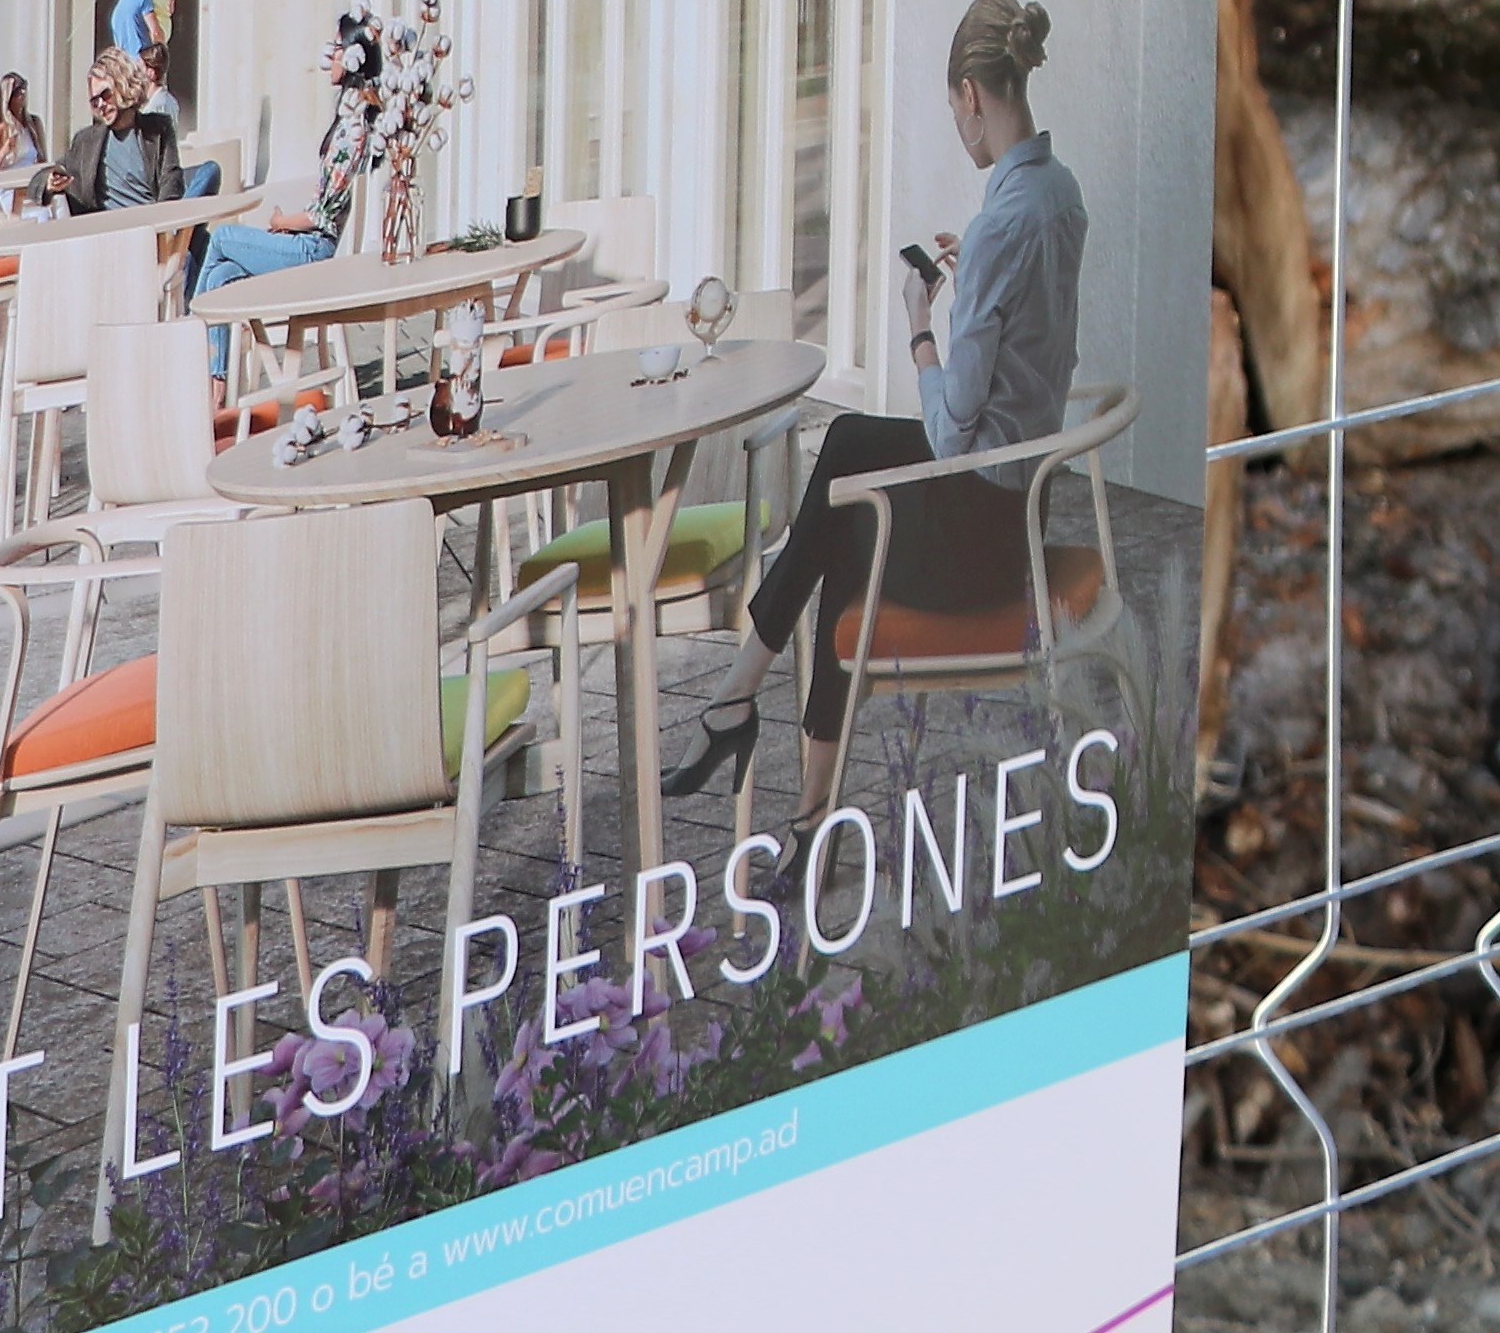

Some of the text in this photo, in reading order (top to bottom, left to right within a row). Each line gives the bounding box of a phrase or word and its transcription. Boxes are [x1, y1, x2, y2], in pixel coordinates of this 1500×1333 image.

[122, 957, 374, 1180] LES
[448, 730, 1119, 1076] PERSONES
[226, 1286, 297, 1333] 200
[311, 1284, 335, 1313] o
[348, 1252, 395, 1301] bé
[408, 1251, 428, 1279] a
[443, 1108, 799, 1267] www.comuencamp.ad
